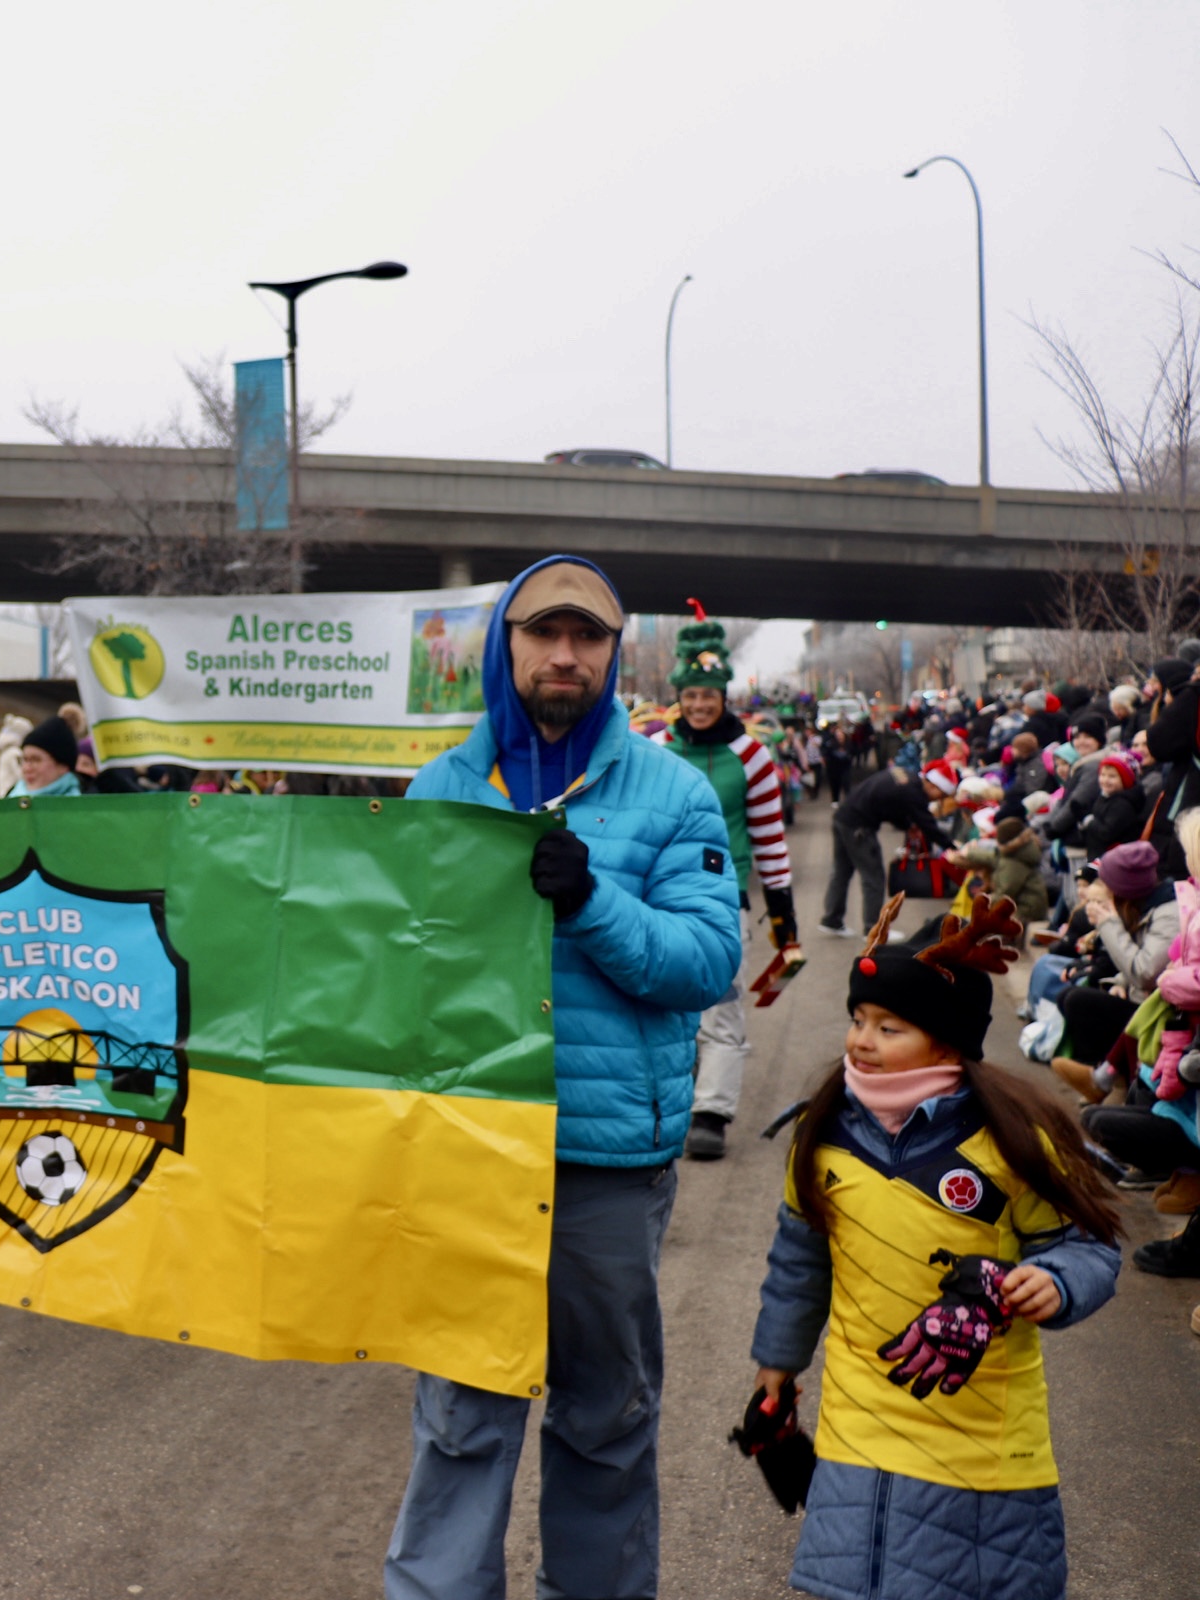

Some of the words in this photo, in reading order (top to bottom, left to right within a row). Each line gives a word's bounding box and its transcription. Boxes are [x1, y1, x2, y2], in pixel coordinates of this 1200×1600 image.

[227, 614, 353, 643] Alerces
[185, 650, 275, 675] Spanish
[283, 649, 390, 672] Preschool
[203, 677, 220, 697] &
[228, 676, 373, 703] Kindergarten
